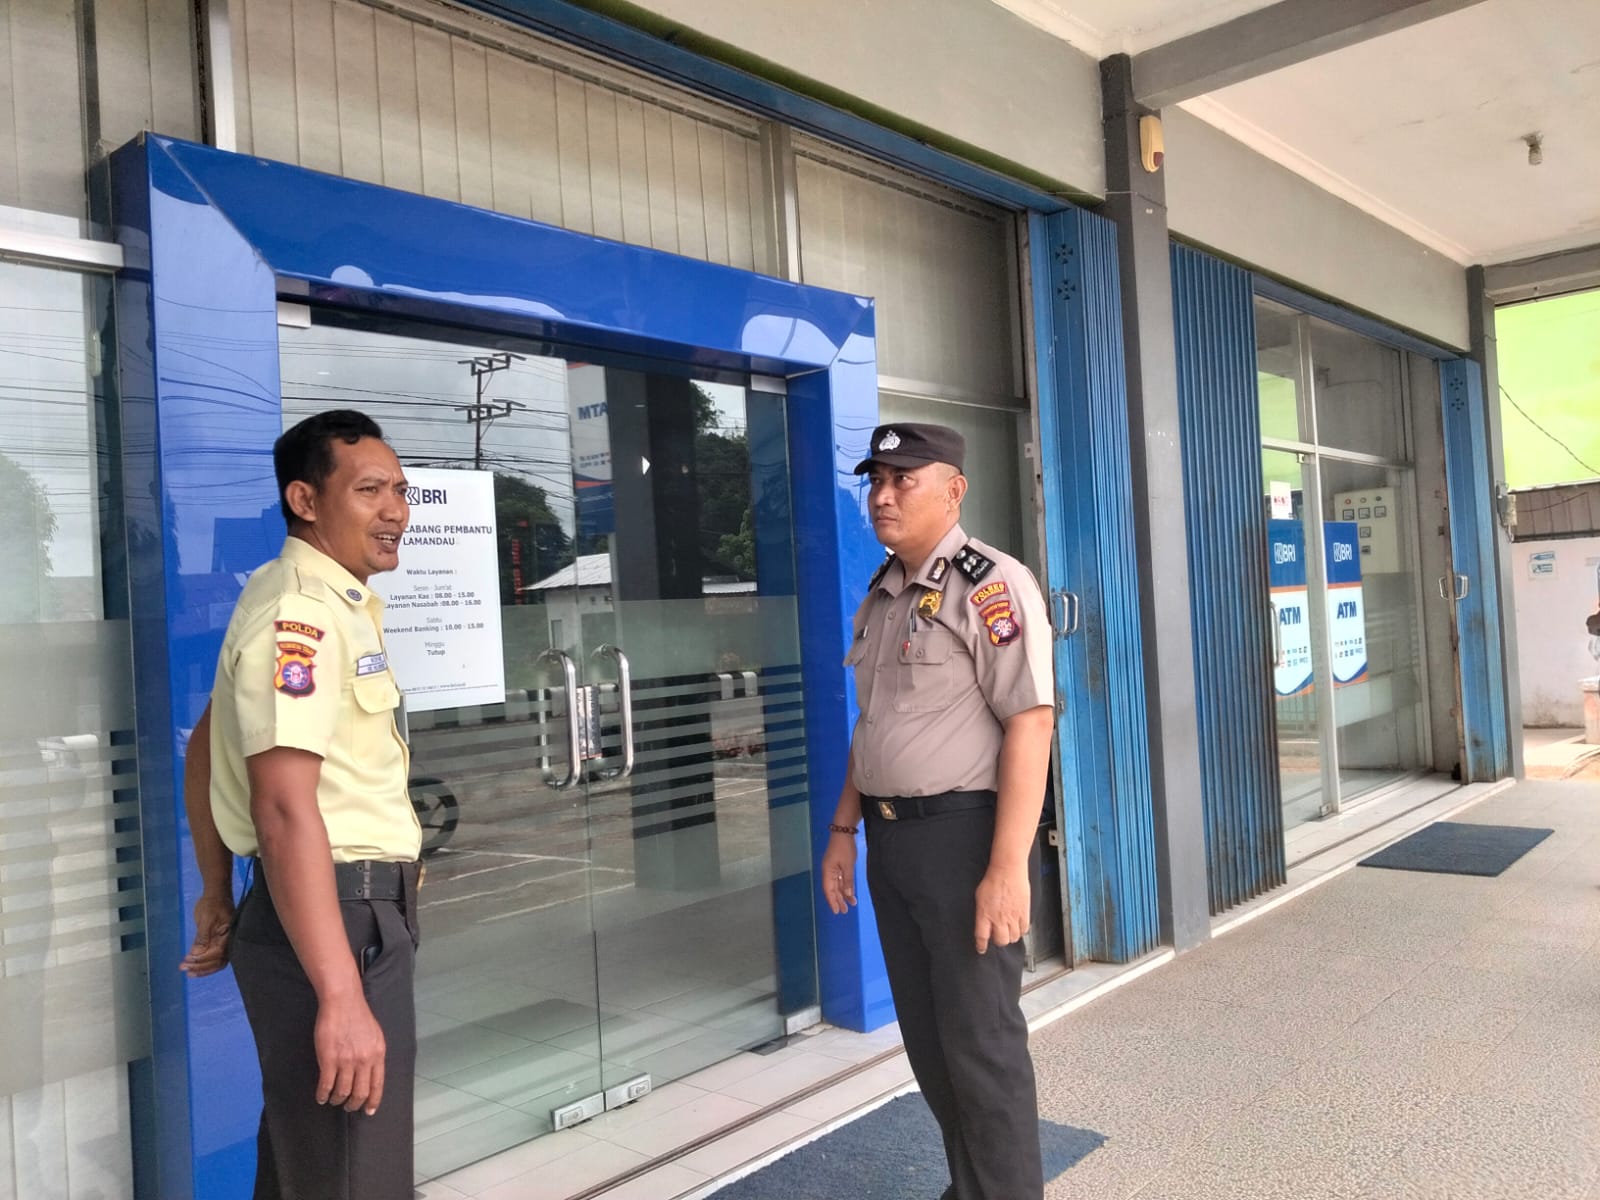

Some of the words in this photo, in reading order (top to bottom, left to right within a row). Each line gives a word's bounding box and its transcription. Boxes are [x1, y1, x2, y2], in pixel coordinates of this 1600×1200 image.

[422, 489, 447, 504] BRI
[444, 525, 493, 534] PEMBANTU
[403, 537, 455, 546] LAMANDAU
[428, 569, 454, 577] Layanan
[390, 594, 417, 602] Layanan
[1336, 601, 1357, 619] ATM
[1280, 606, 1301, 626] ATM
[281, 622, 319, 638] POLDA
[383, 626, 413, 634] Weekend
